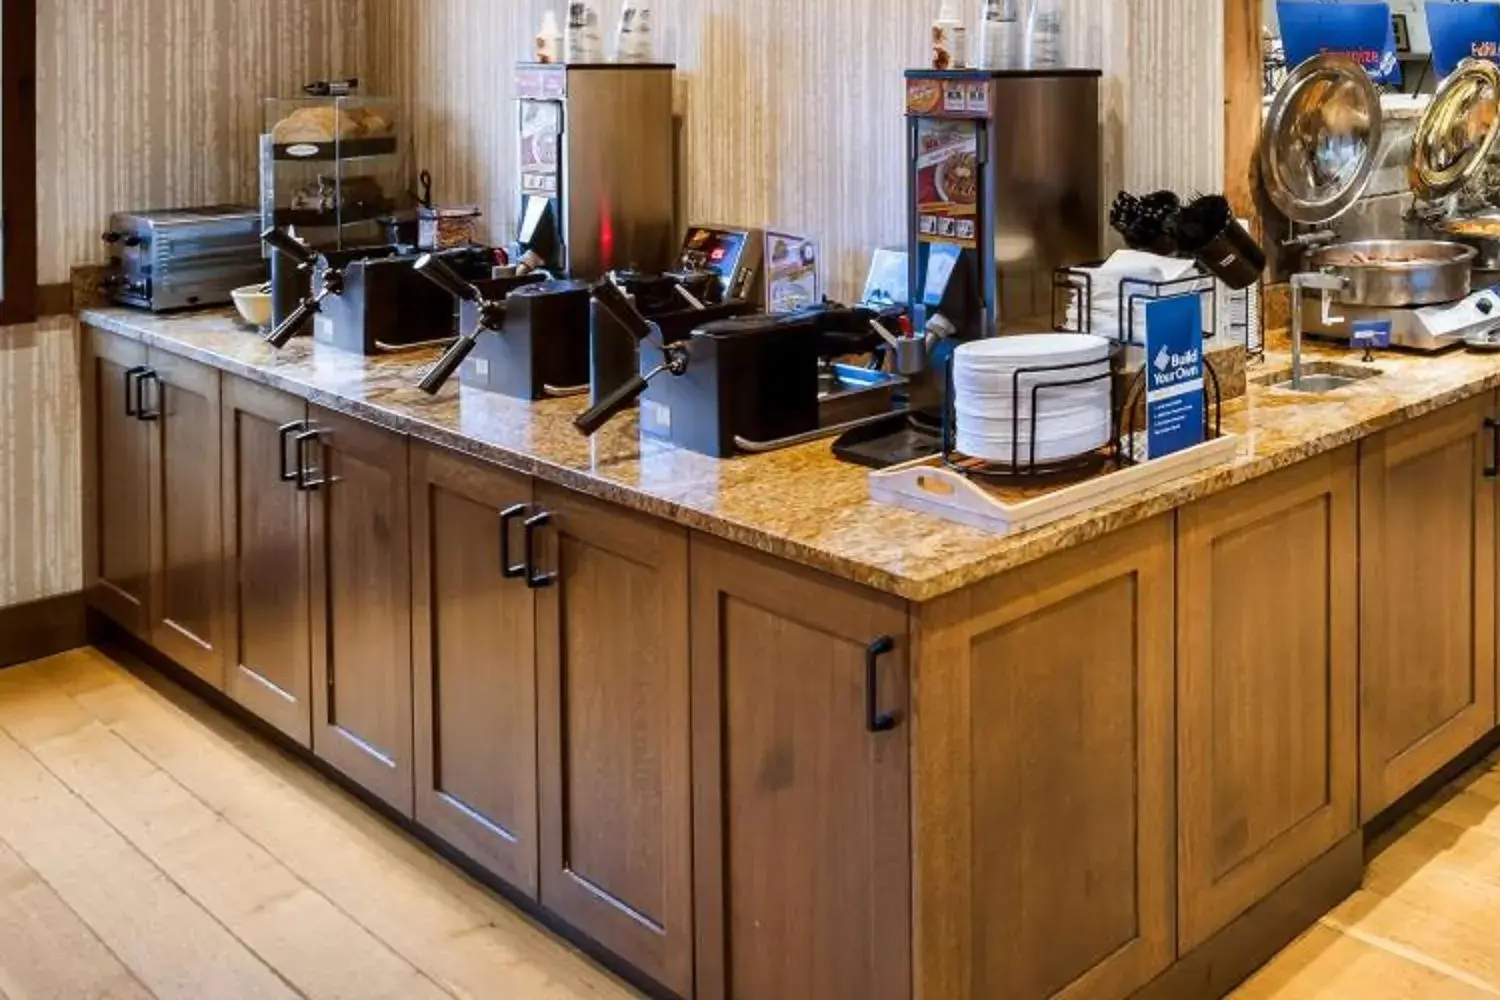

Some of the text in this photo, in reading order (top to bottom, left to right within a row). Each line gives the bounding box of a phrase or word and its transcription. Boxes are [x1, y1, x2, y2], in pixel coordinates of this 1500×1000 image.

[1171, 348, 1198, 367] Build
[1153, 366, 1199, 385] Your Own
